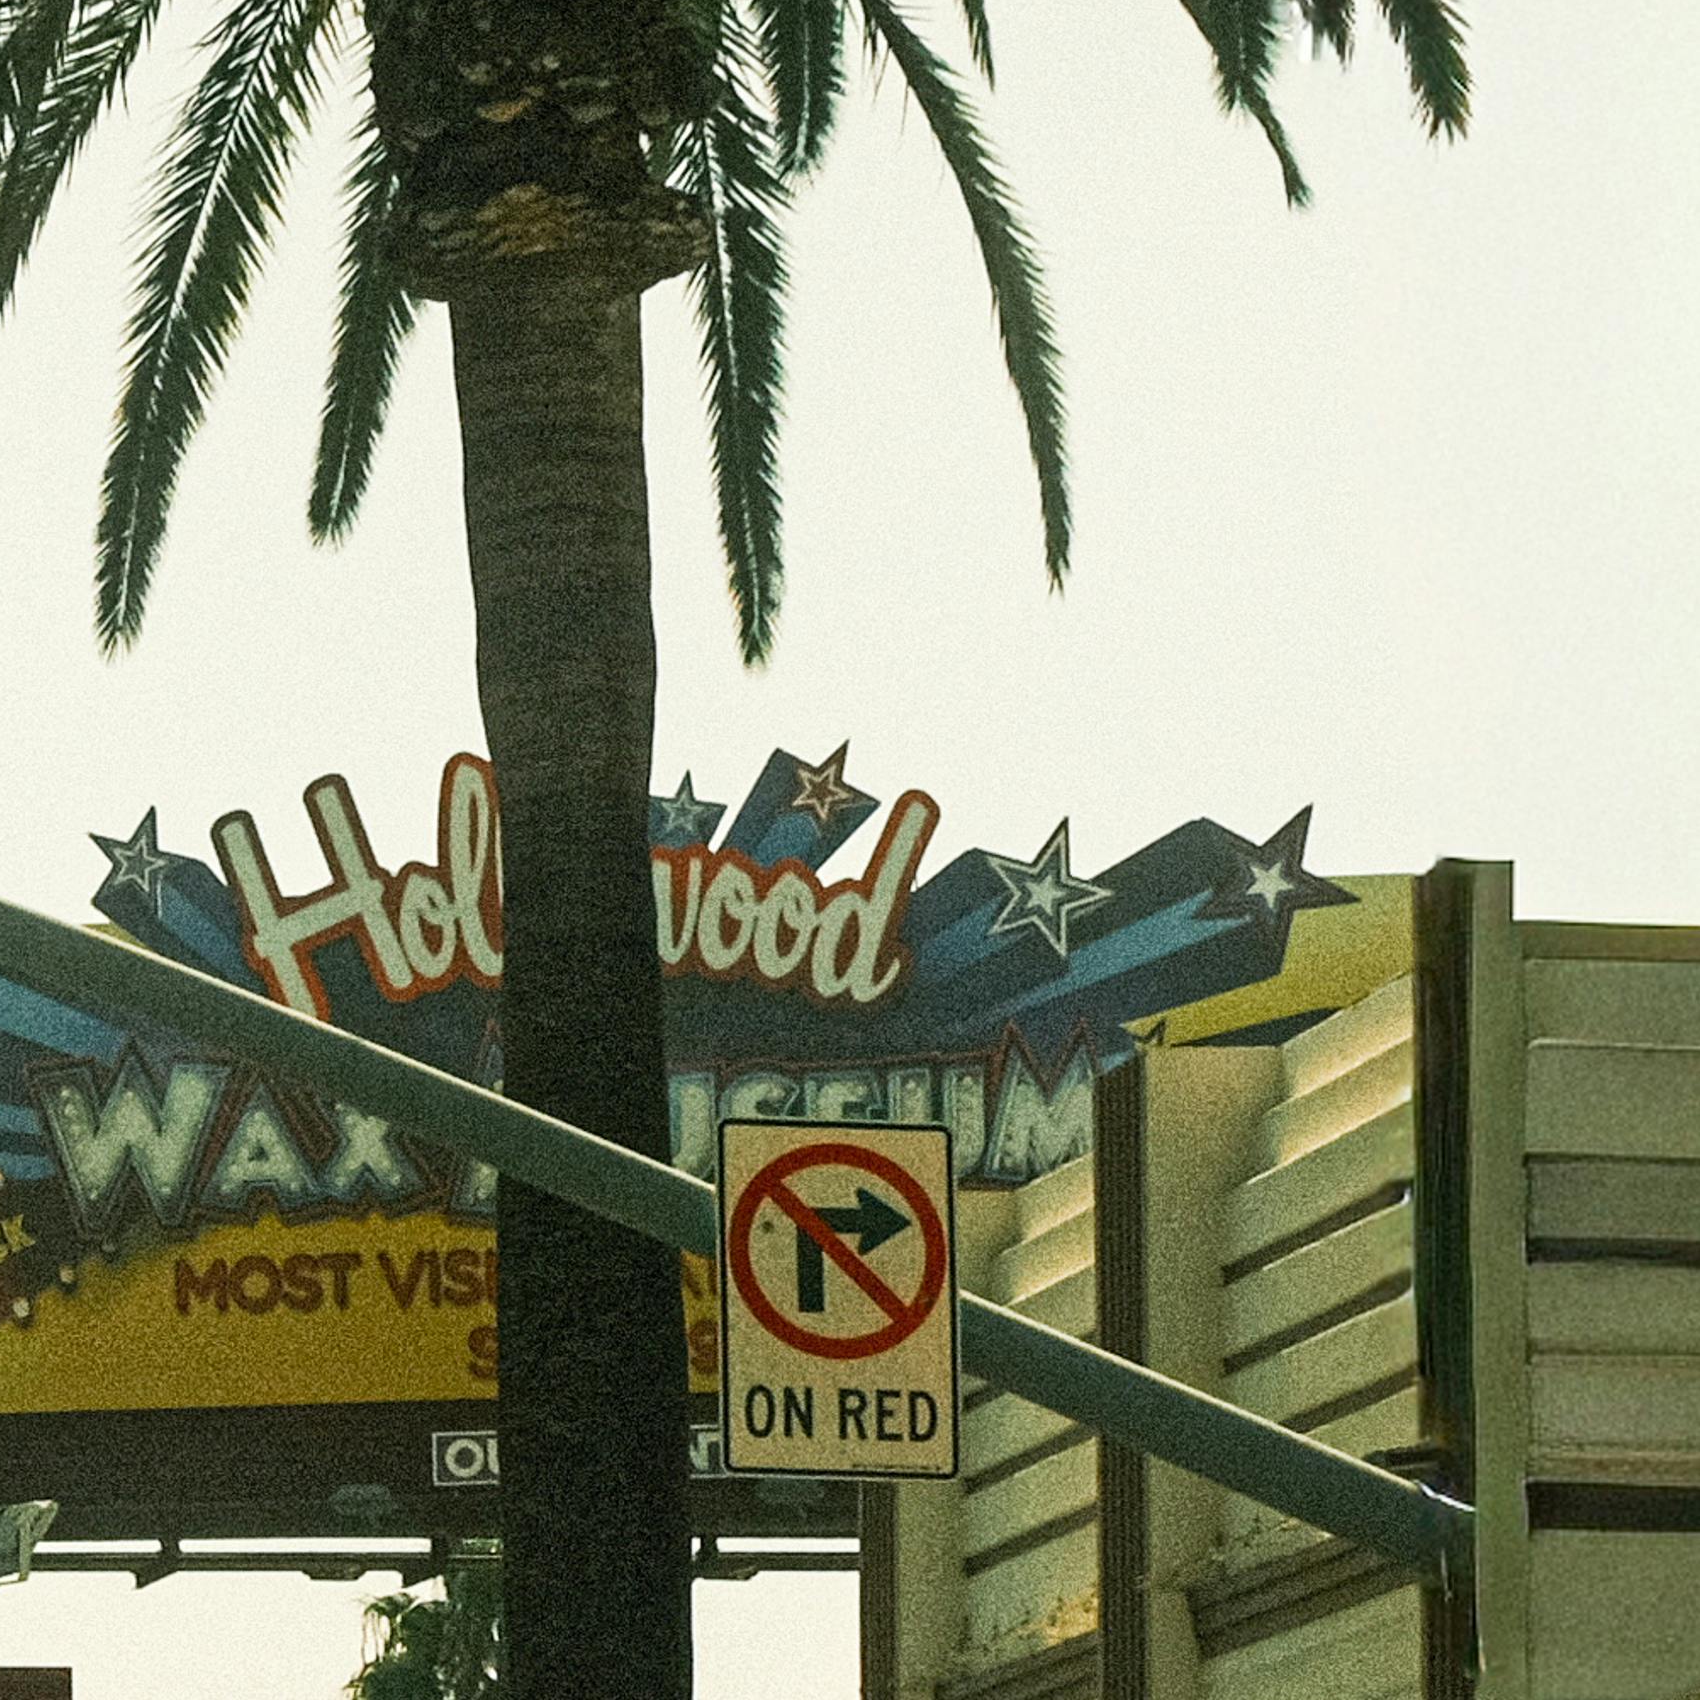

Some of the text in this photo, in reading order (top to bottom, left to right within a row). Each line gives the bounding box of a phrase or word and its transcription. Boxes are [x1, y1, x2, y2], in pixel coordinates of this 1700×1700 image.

[174, 1251, 363, 1316] MOST
[744, 1383, 938, 1443] ON RED
